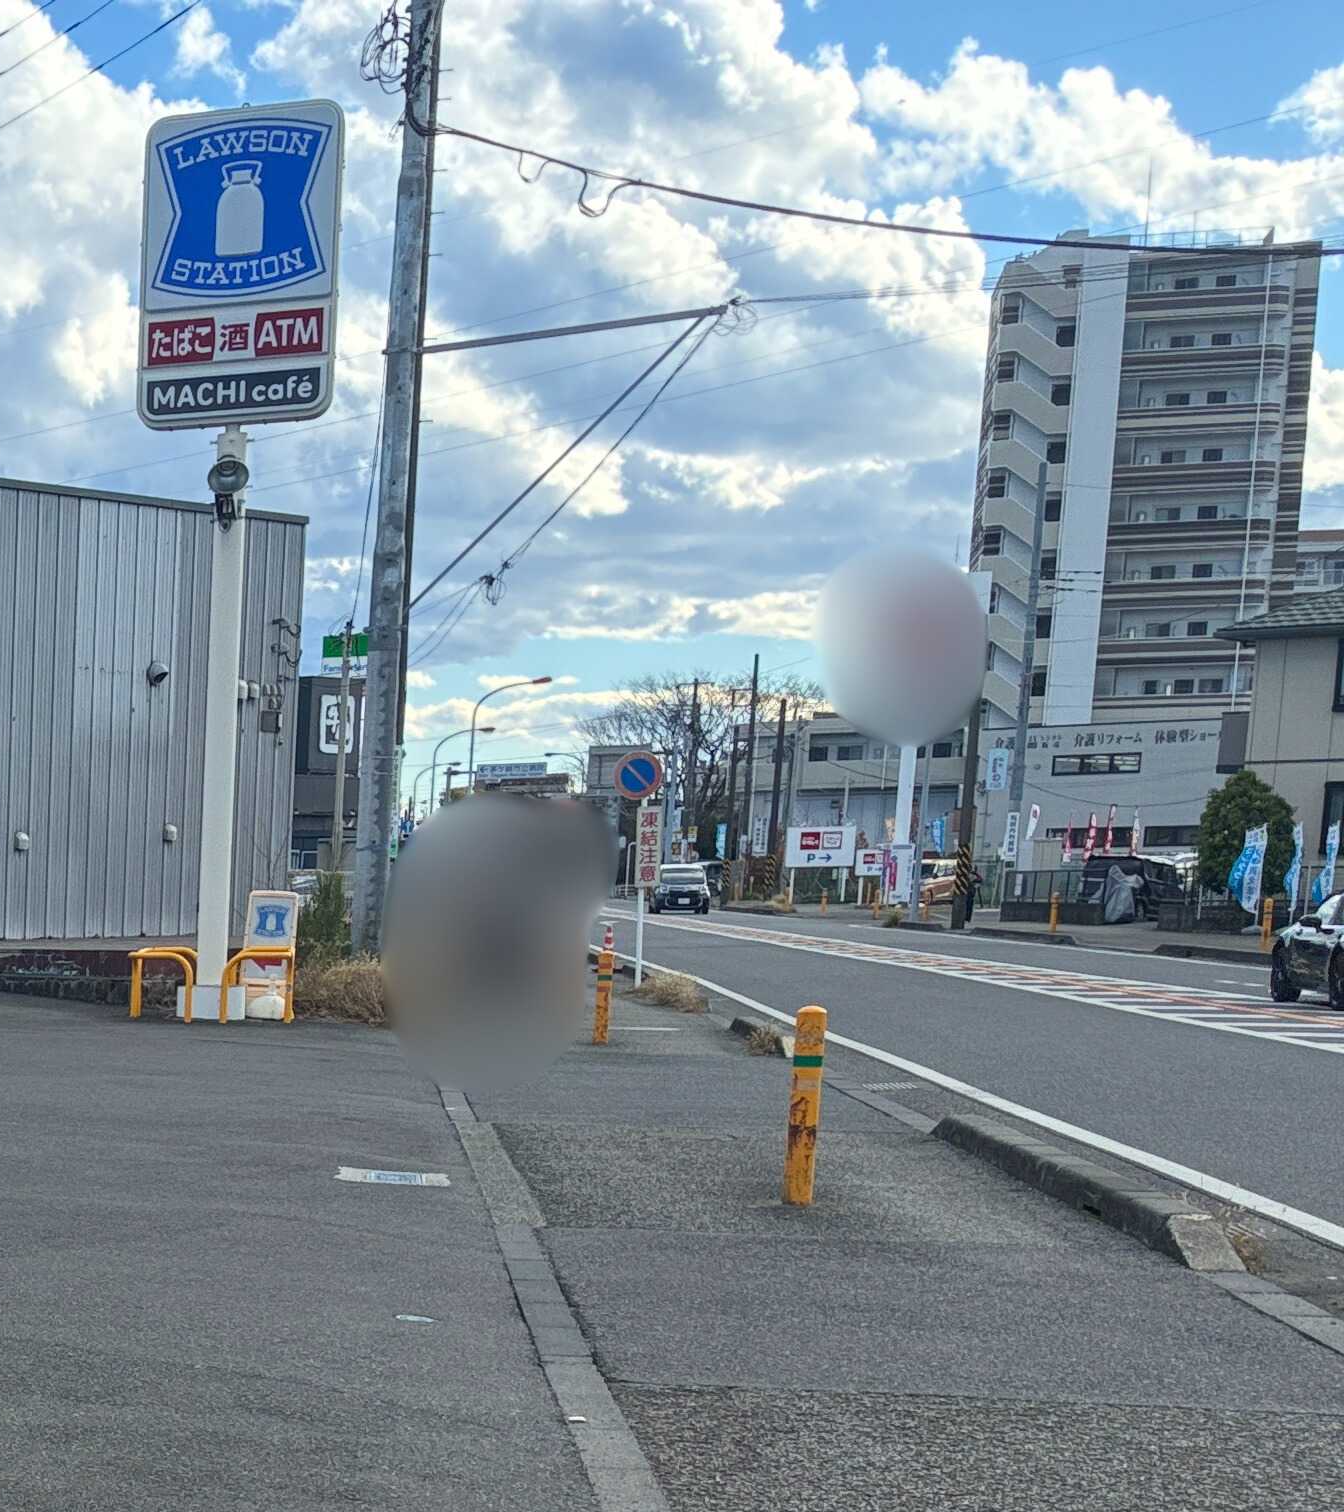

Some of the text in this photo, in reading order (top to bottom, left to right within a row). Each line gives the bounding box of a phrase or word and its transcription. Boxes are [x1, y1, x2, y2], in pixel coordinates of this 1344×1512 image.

[173, 130, 314, 170] LAWSON
[171, 247, 306, 284] STATION
[151, 316, 319, 359] たばこ 酒 ATM
[152, 375, 313, 410] MACHI café
[1074, 732, 1142, 748] 介護リフォーム
[640, 811, 658, 882] 凍結注意
[807, 854, 815, 863] P
